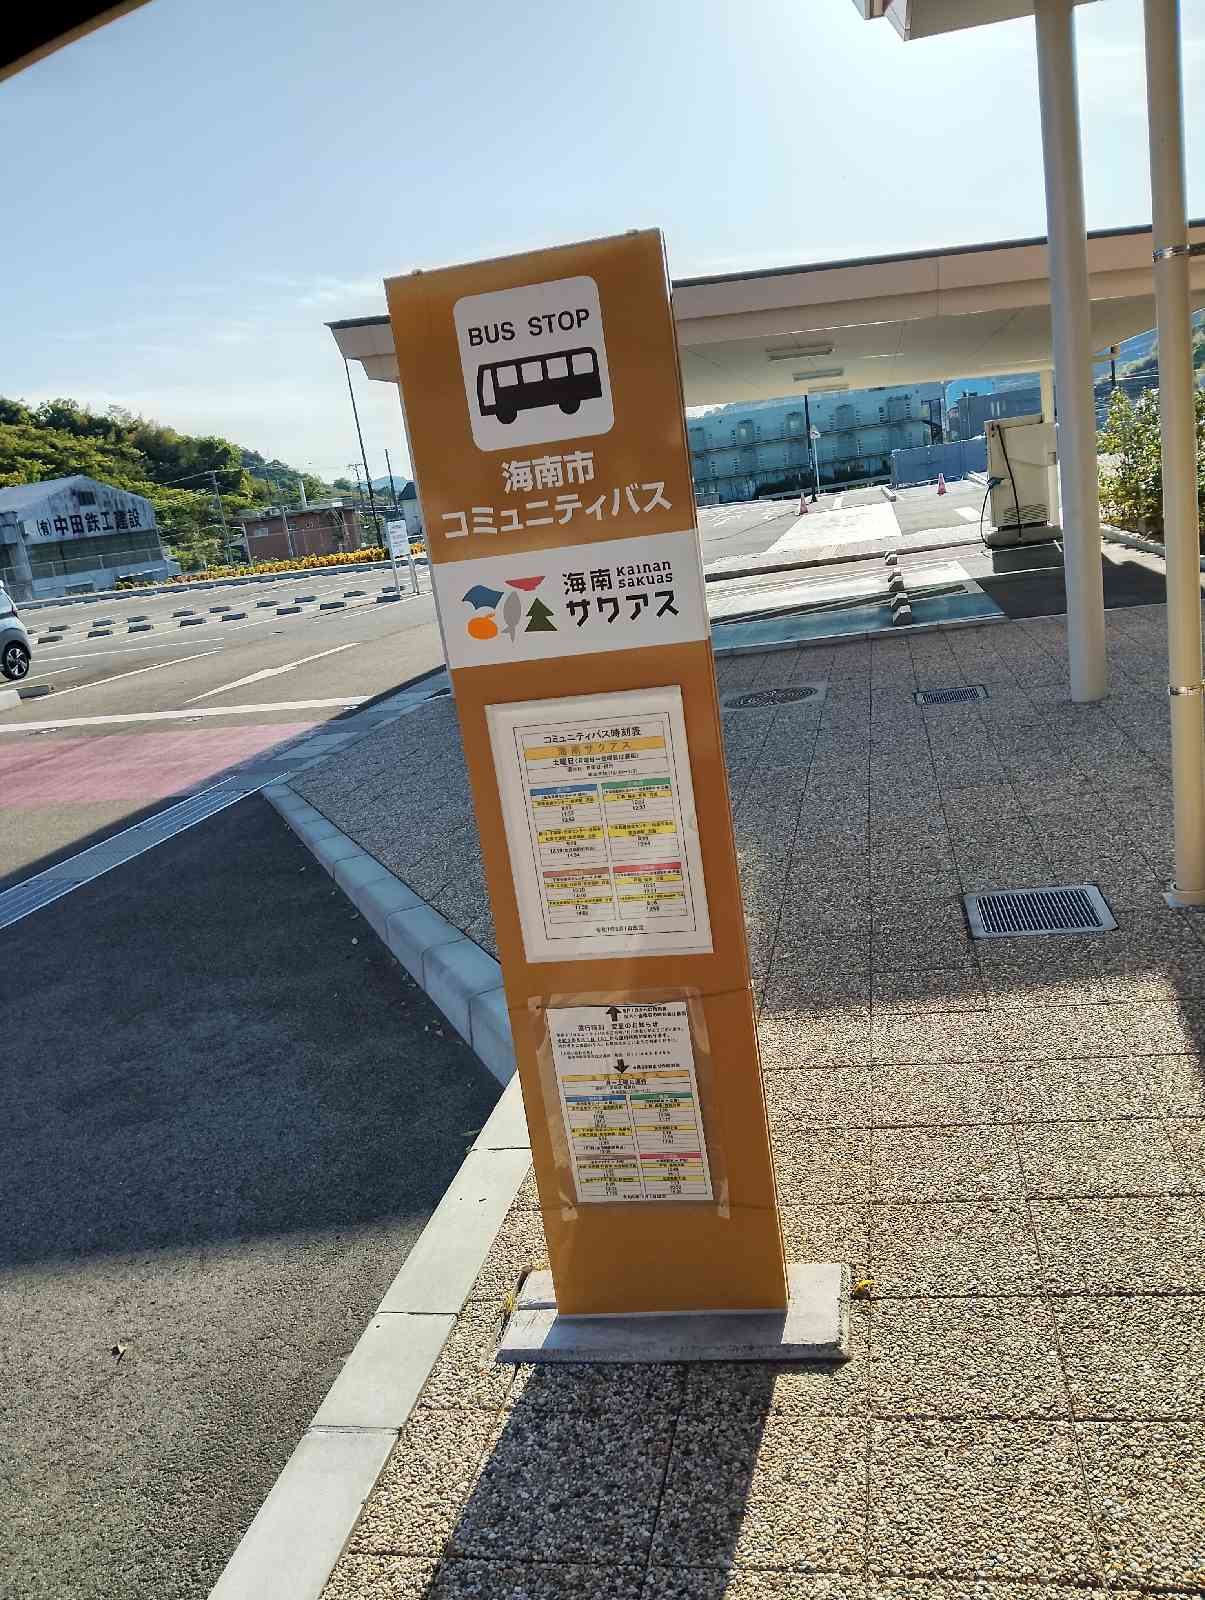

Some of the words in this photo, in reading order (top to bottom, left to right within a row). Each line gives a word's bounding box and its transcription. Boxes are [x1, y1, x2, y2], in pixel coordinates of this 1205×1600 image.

[468, 321, 516, 347] BUS
[527, 308, 590, 336] STOP
[502, 450, 594, 494] 海南市
[441, 481, 673, 539] コミュニティバス
[562, 568, 613, 595] 海南
[566, 590, 679, 627] サクアス
